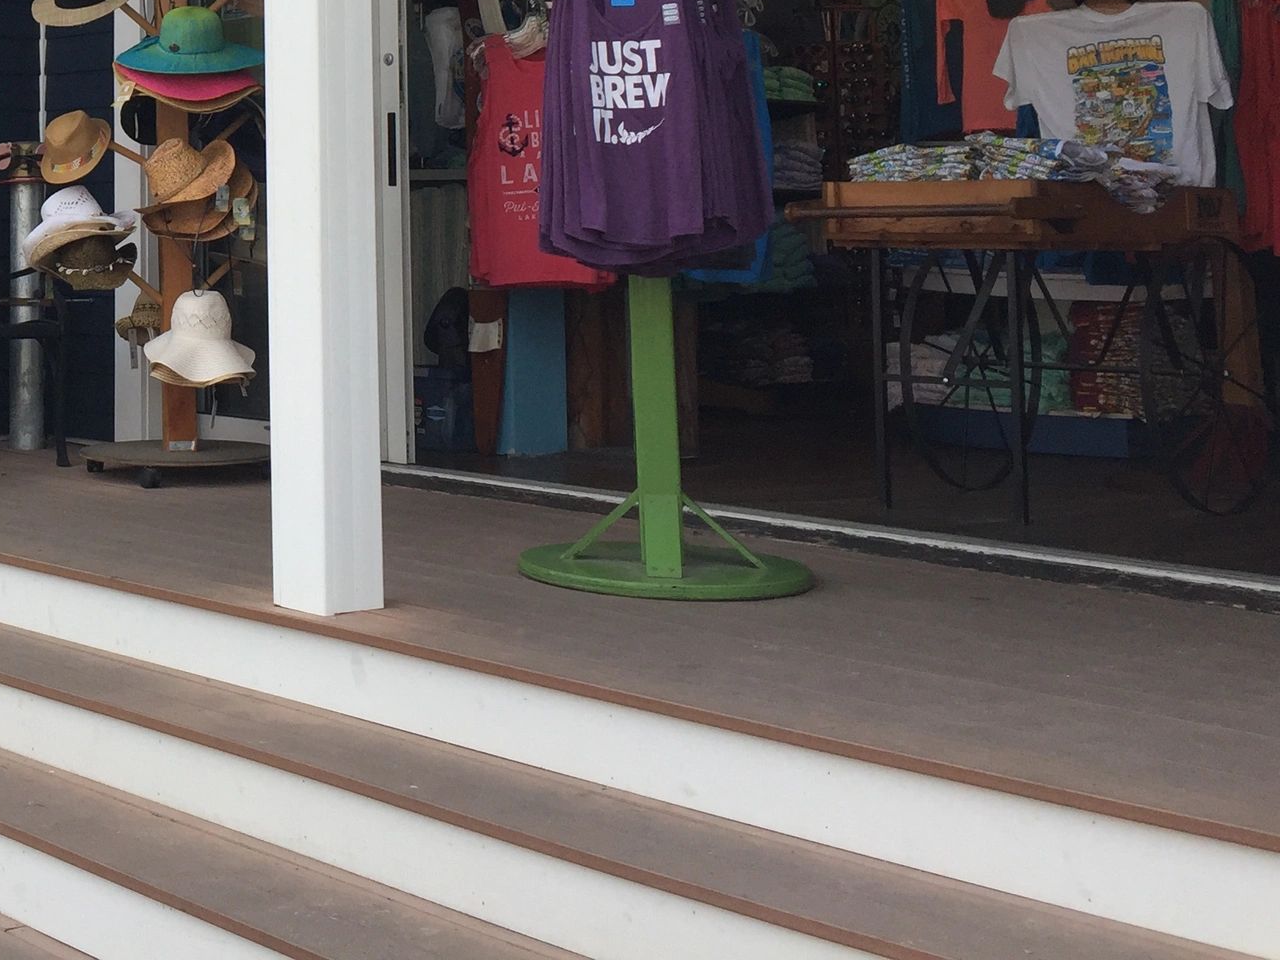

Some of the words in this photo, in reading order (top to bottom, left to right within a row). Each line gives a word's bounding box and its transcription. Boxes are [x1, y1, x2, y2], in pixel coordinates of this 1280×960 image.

[589, 40, 662, 74] JUST
[589, 73, 670, 109] BREW
[593, 108, 618, 145] IT.
